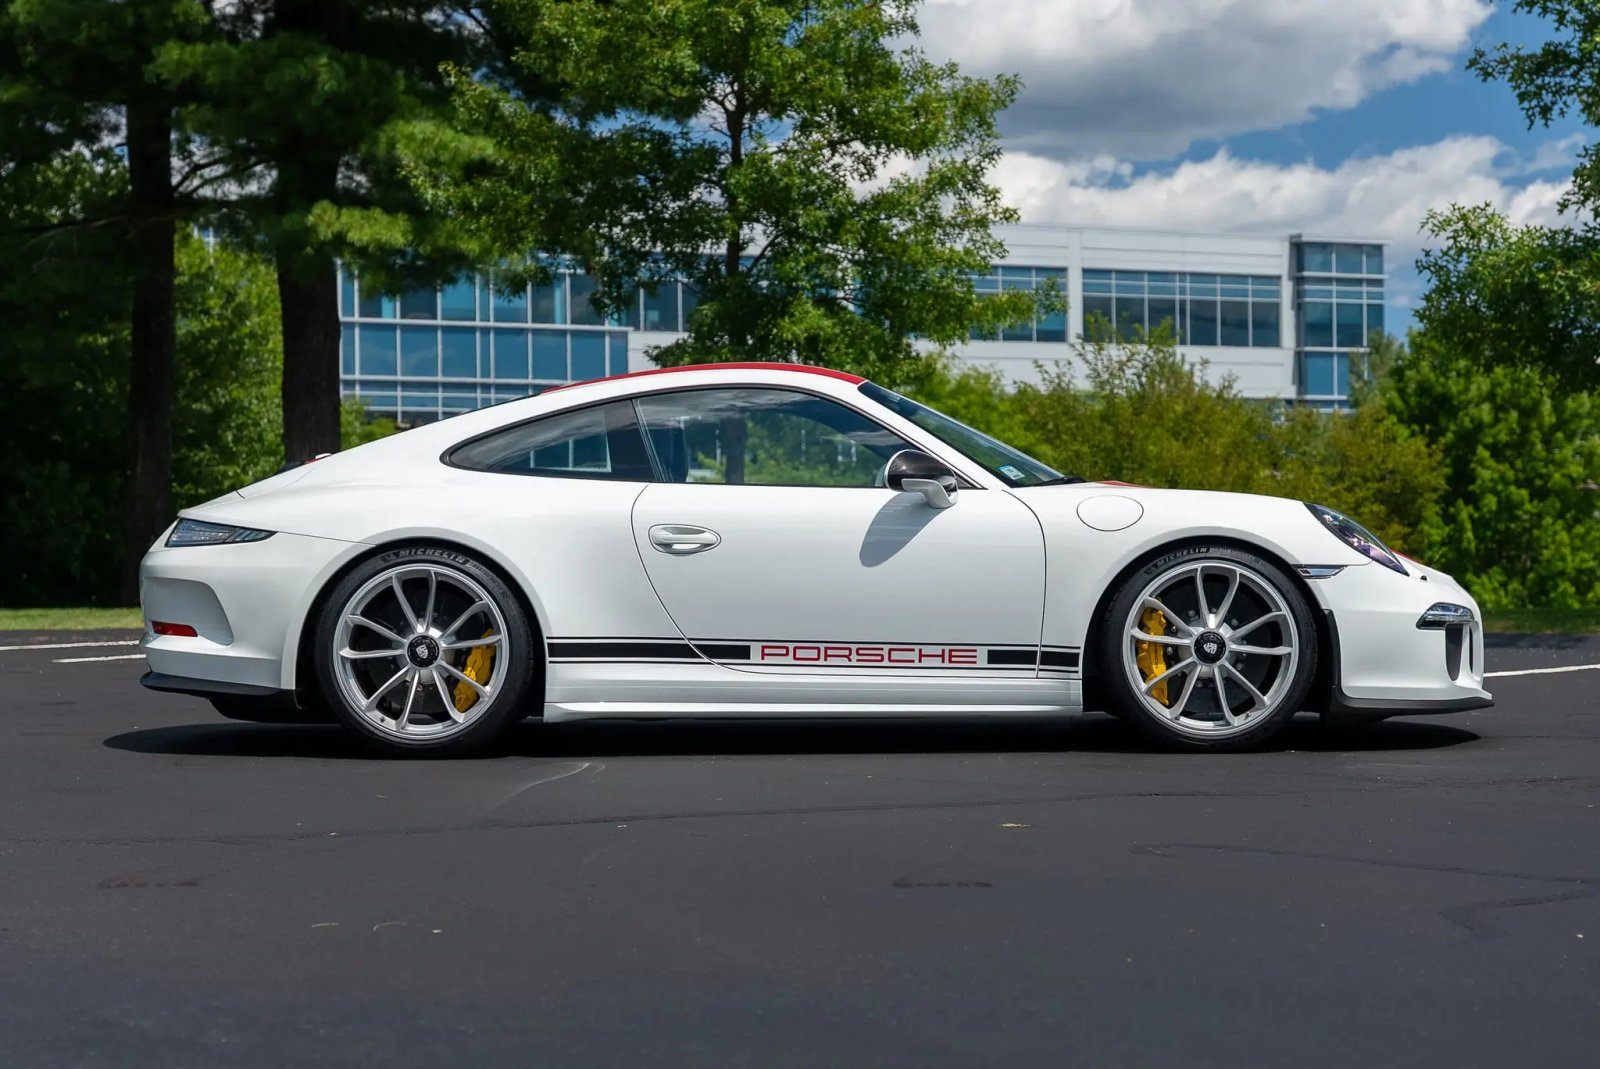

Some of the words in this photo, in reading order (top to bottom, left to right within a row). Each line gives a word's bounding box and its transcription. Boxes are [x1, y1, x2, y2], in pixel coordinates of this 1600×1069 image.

[399, 548, 466, 563] MICHELIN
[1157, 547, 1208, 567] MICHELIN
[760, 645, 977, 665] PORSCHE
